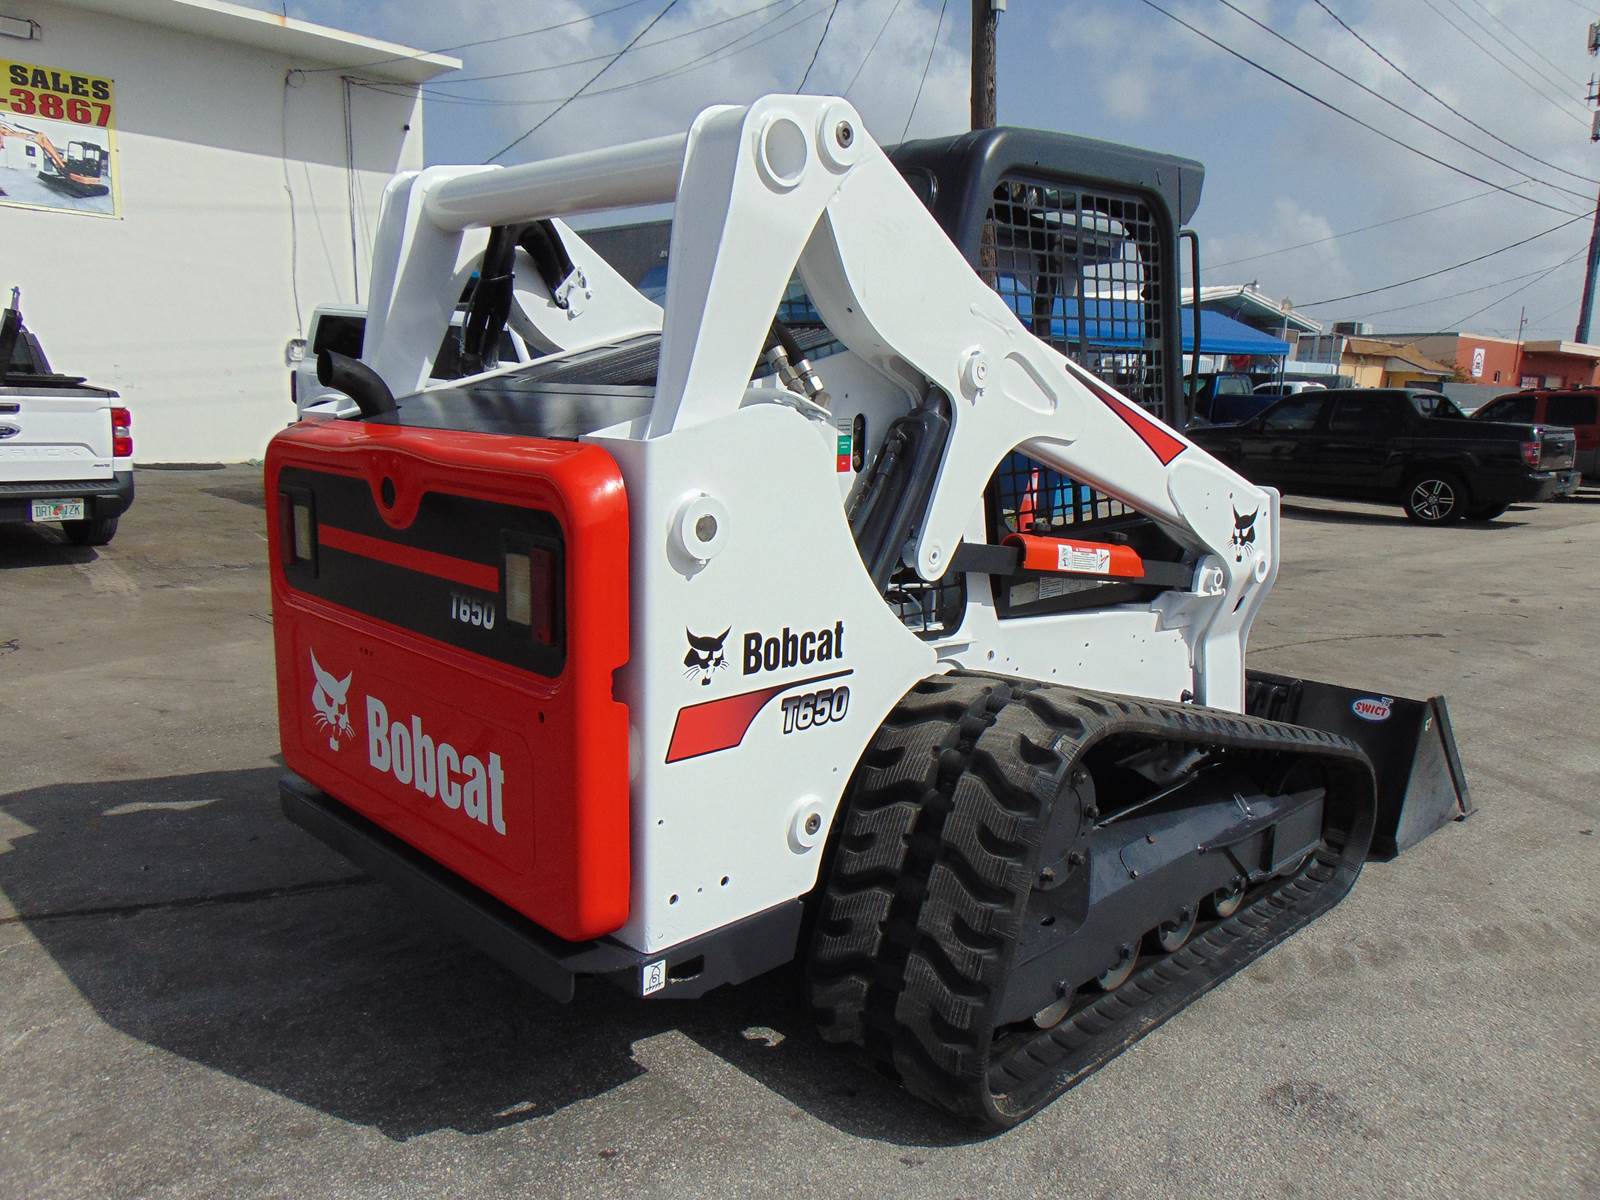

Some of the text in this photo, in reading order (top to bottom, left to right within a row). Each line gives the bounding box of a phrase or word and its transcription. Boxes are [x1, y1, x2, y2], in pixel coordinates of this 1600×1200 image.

[9, 64, 110, 100] SALES
[449, 592, 496, 630] T650
[743, 621, 844, 675] Bobcat
[781, 685, 850, 734] T650
[1355, 702, 1388, 717] SWICT
[366, 694, 507, 836] Bobcat
